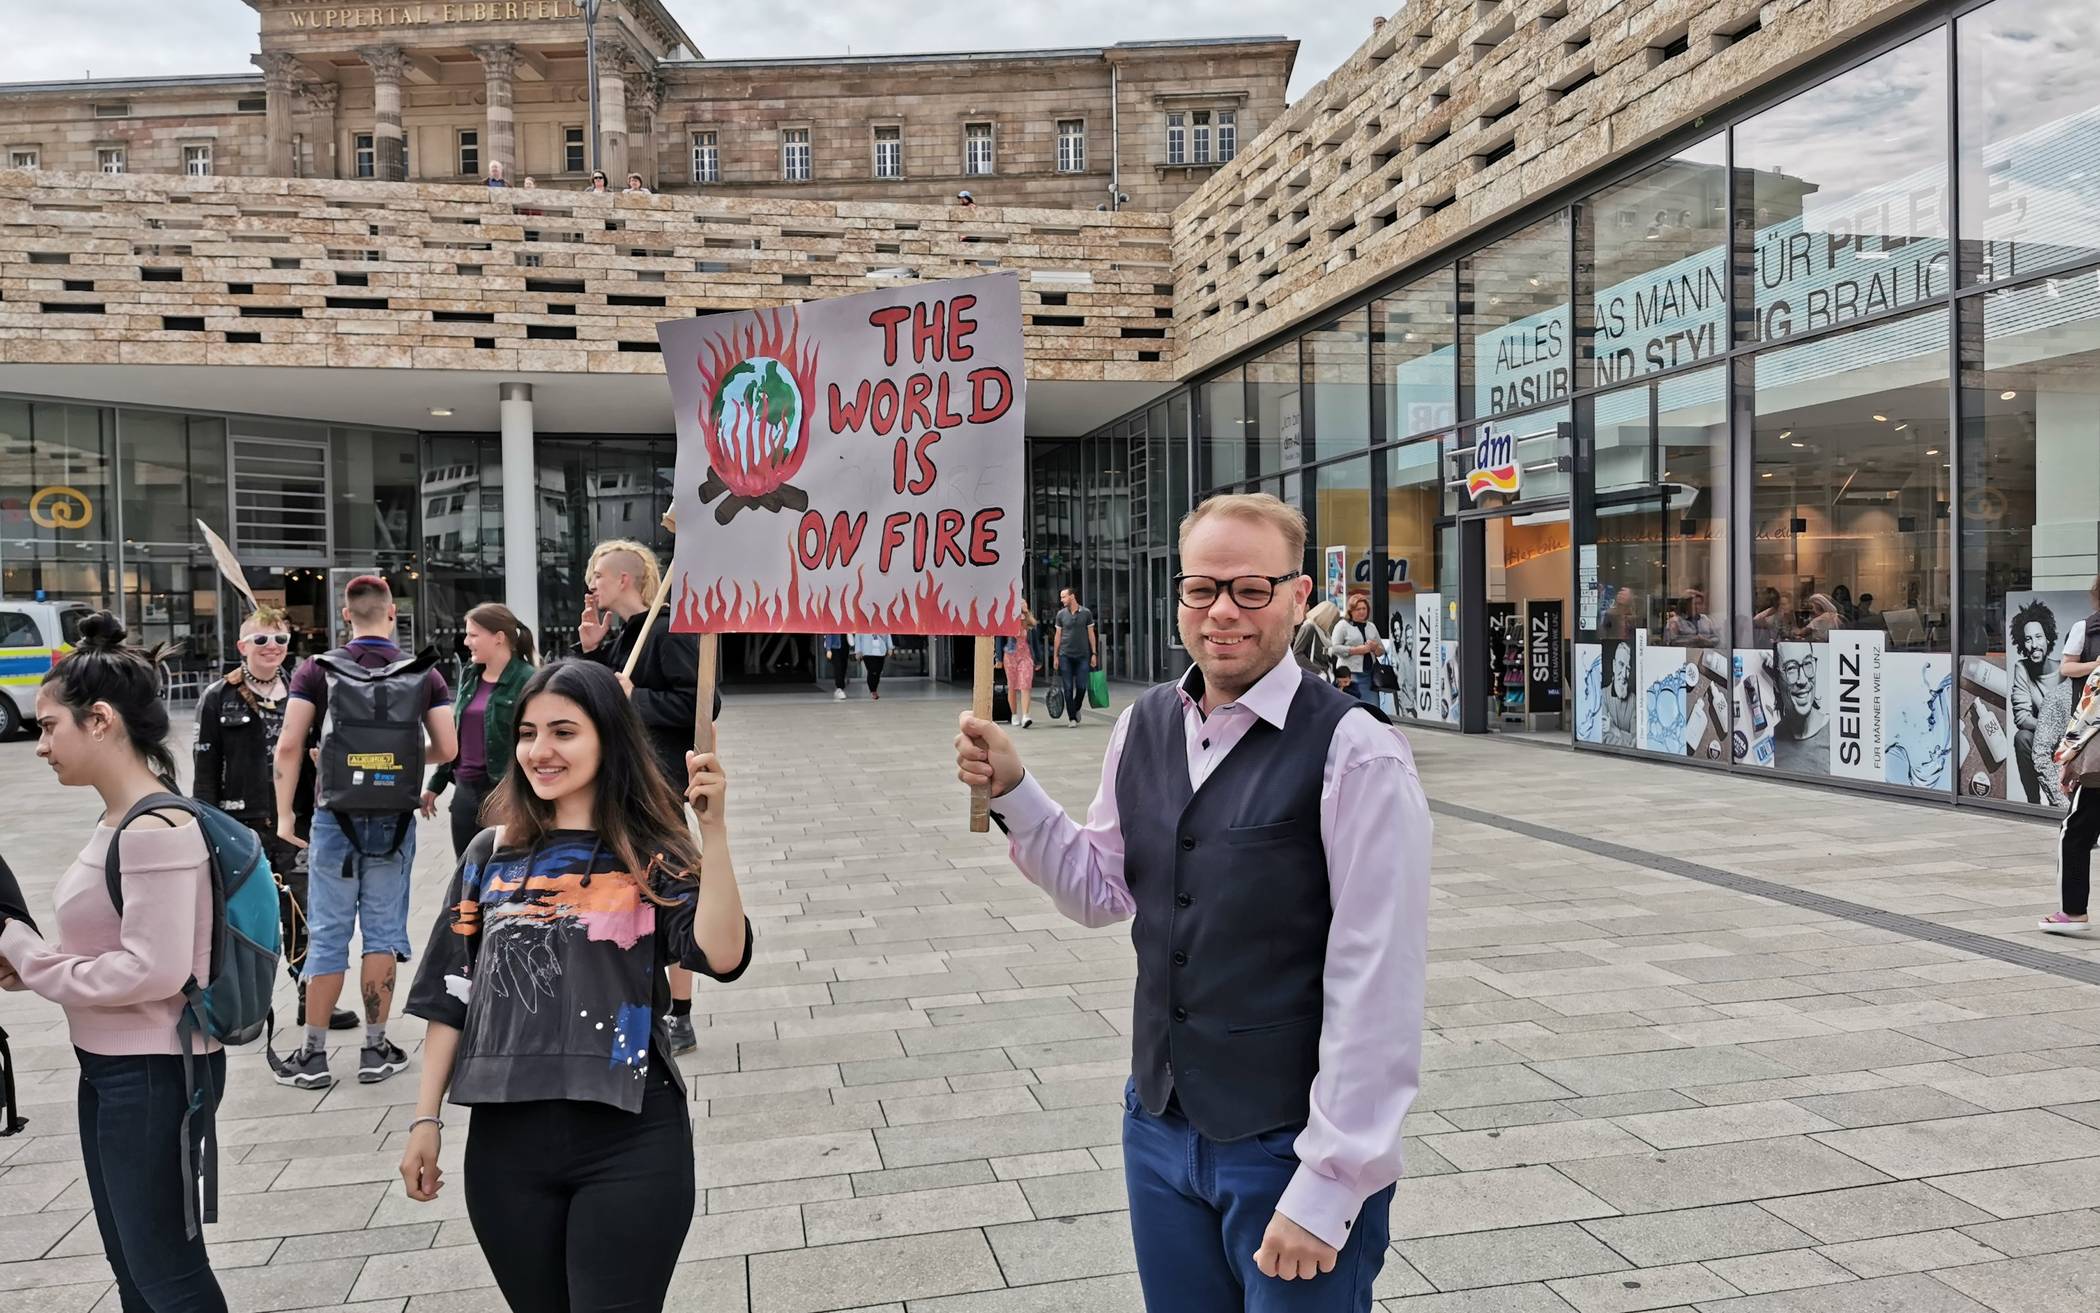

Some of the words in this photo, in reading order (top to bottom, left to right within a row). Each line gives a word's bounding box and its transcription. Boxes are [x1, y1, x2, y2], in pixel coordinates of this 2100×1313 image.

[289, 5, 429, 28] WUPPERTAL
[443, 0, 581, 22] ELBERFELD
[869, 293, 978, 367] THE
[1495, 319, 1562, 375] ALLES
[1594, 297, 1625, 340] AS
[1635, 259, 1727, 331] MANN
[827, 366, 1013, 436] WORLD
[1491, 367, 1568, 415] RASUR
[1595, 347, 1635, 388] ND
[892, 430, 941, 496] IS
[1477, 426, 1511, 470] dm
[797, 507, 868, 572] ON
[878, 505, 1005, 574] FIRE
[1355, 550, 1407, 582] dm
[1419, 606, 1432, 712] SEINZ.
[1532, 611, 1549, 682] SEINZ.
[1873, 643, 1881, 669] UNZ.
[1839, 643, 1861, 766] SEINZ.
[1873, 672, 1881, 693] WIE
[1873, 696, 1881, 744] MÄNNER
[1873, 747, 1881, 769] FÜR
